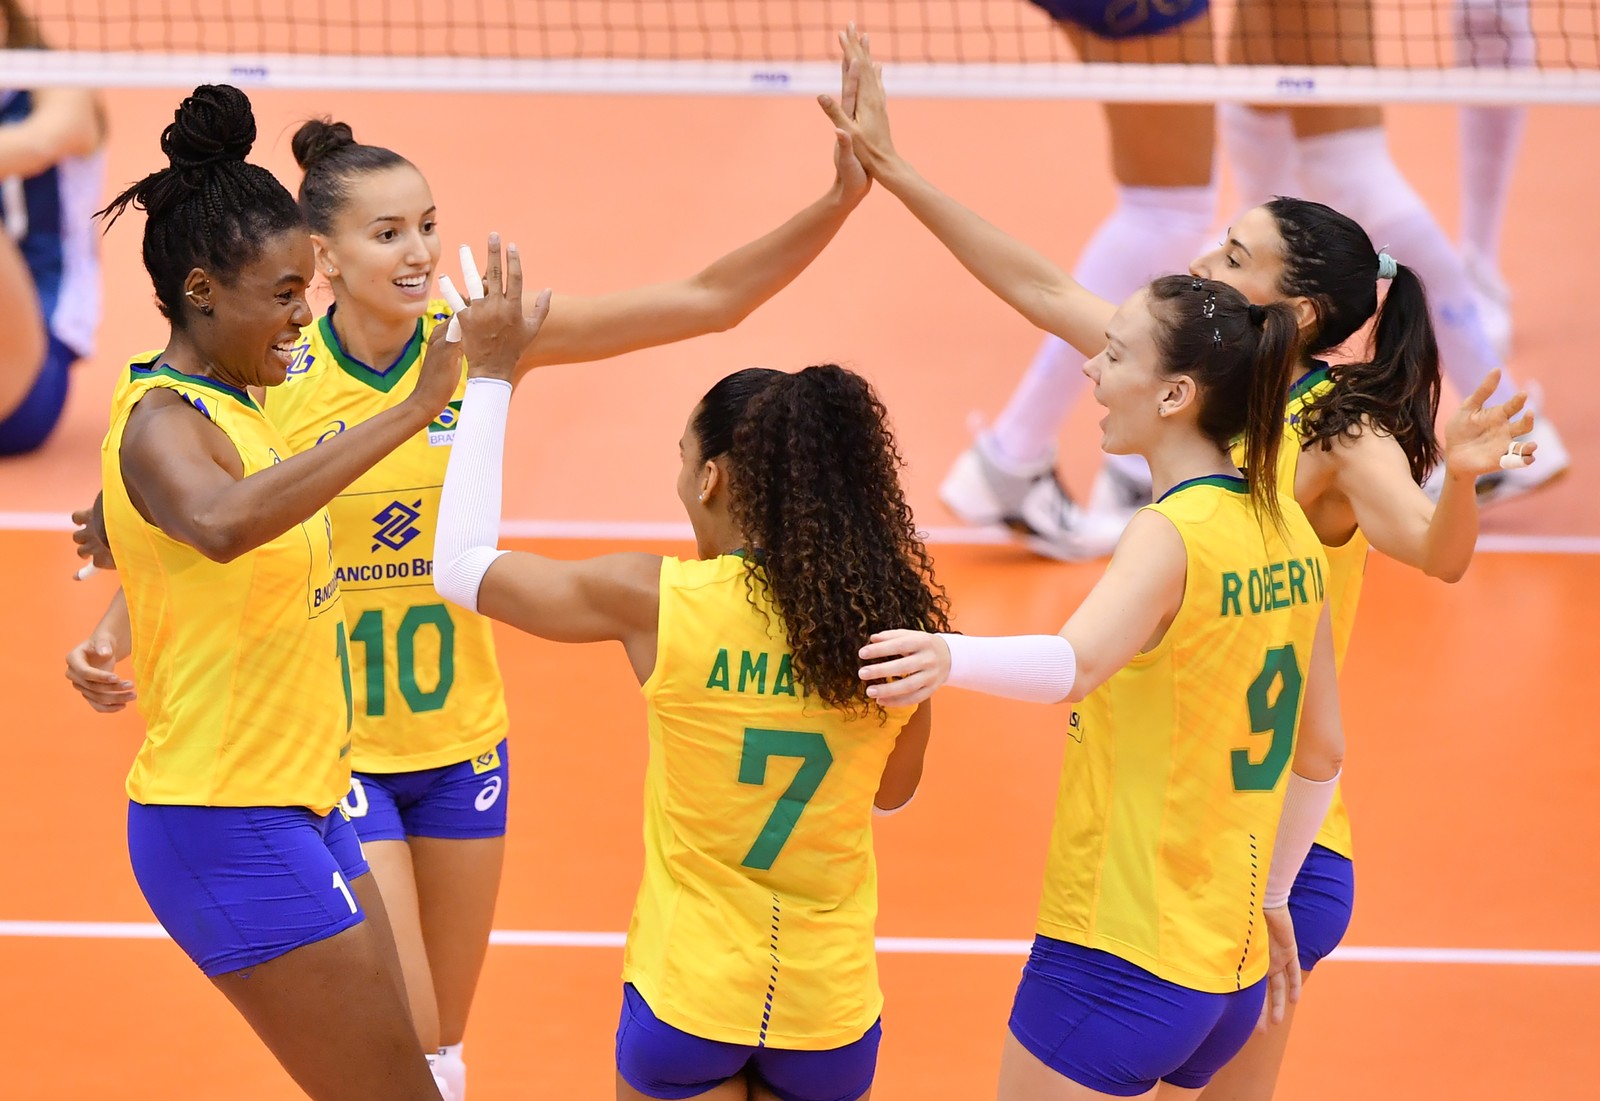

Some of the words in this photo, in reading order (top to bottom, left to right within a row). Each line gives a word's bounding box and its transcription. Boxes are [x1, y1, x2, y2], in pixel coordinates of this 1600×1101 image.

[430, 433, 455, 445] BRA
[336, 564, 382, 582] ANCO
[386, 562, 409, 579] DO
[350, 604, 454, 716] 10
[706, 648, 812, 698] AMA
[1230, 641, 1303, 792] 9
[738, 727, 834, 870] 7
[332, 871, 358, 914] 1
